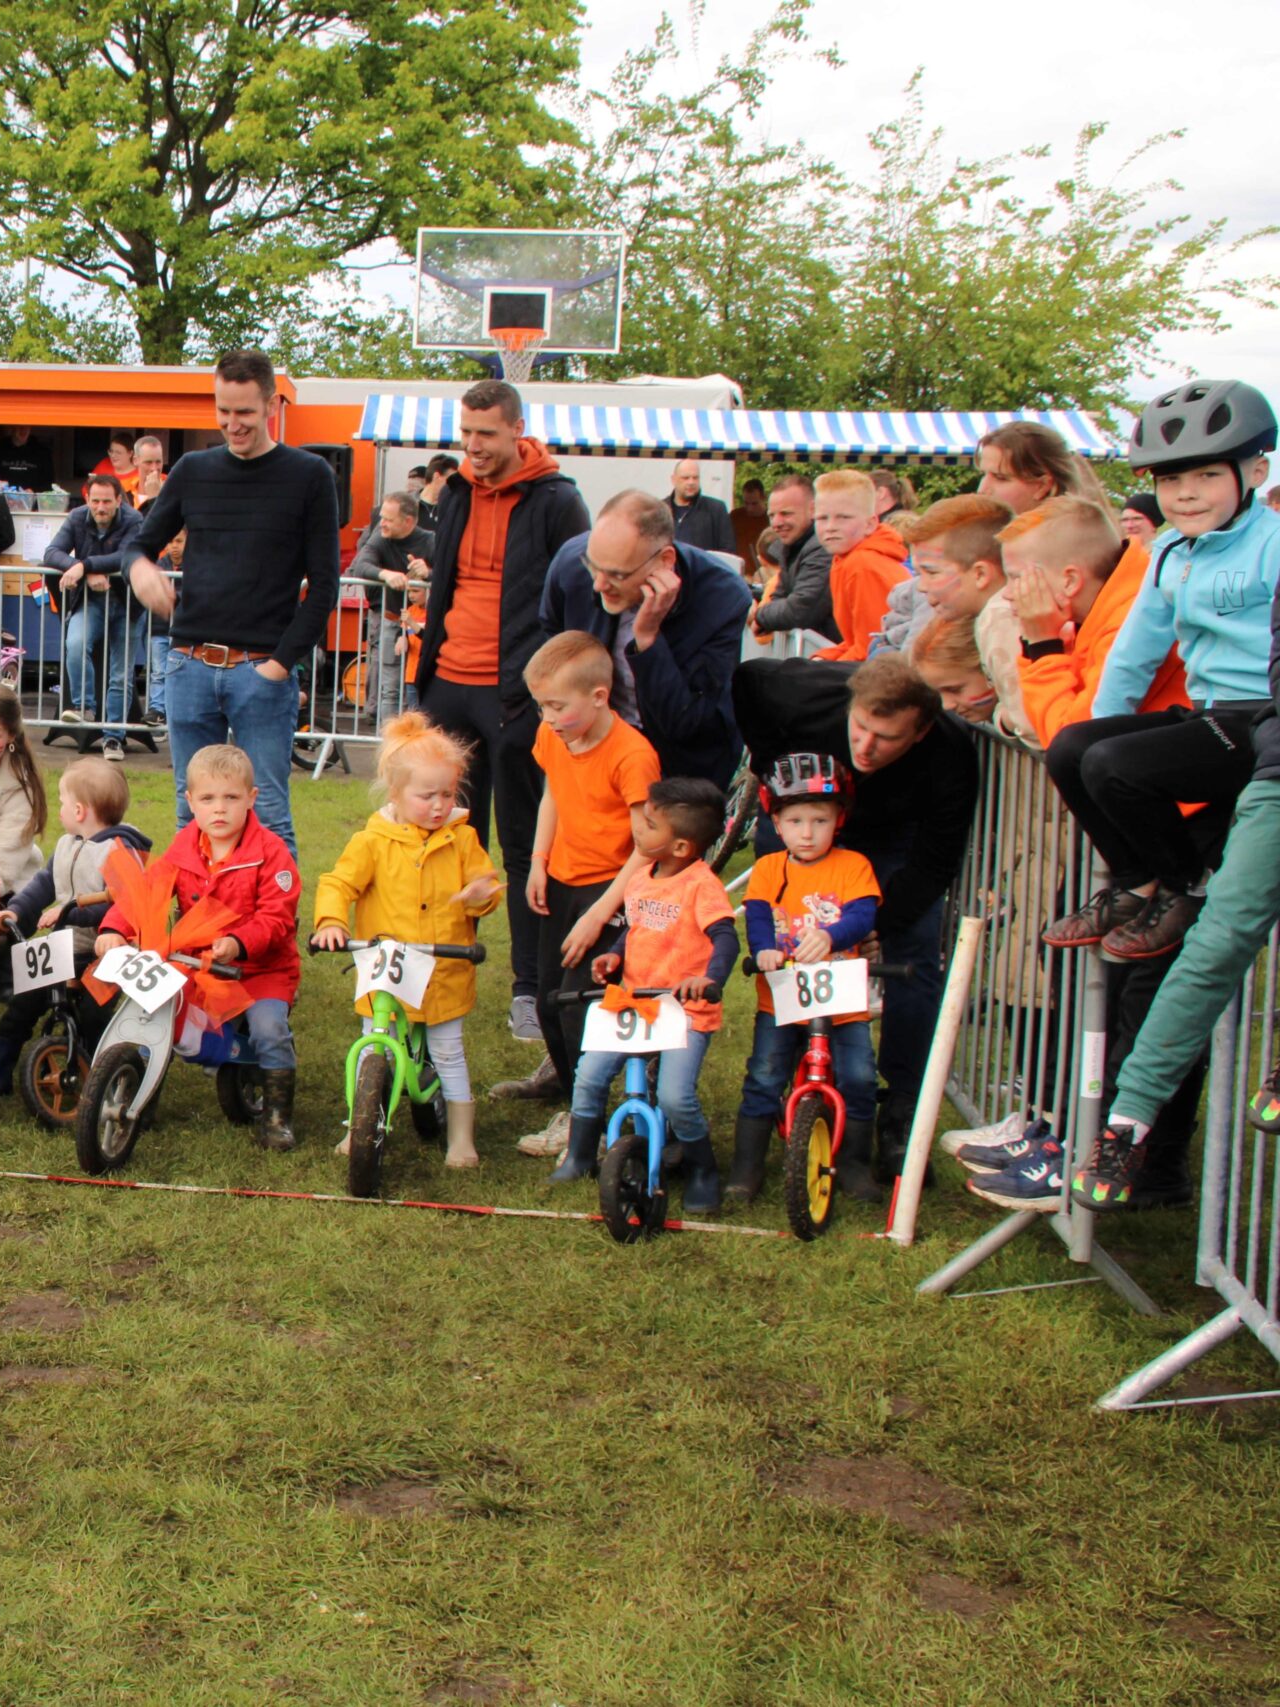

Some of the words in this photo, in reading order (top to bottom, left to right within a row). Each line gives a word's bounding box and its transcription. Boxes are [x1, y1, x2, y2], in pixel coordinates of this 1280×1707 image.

[638, 898, 680, 919] ANGELES
[25, 942, 55, 980] 92
[116, 954, 168, 992] 155
[370, 948, 406, 986] 95
[795, 968, 833, 1009] 88
